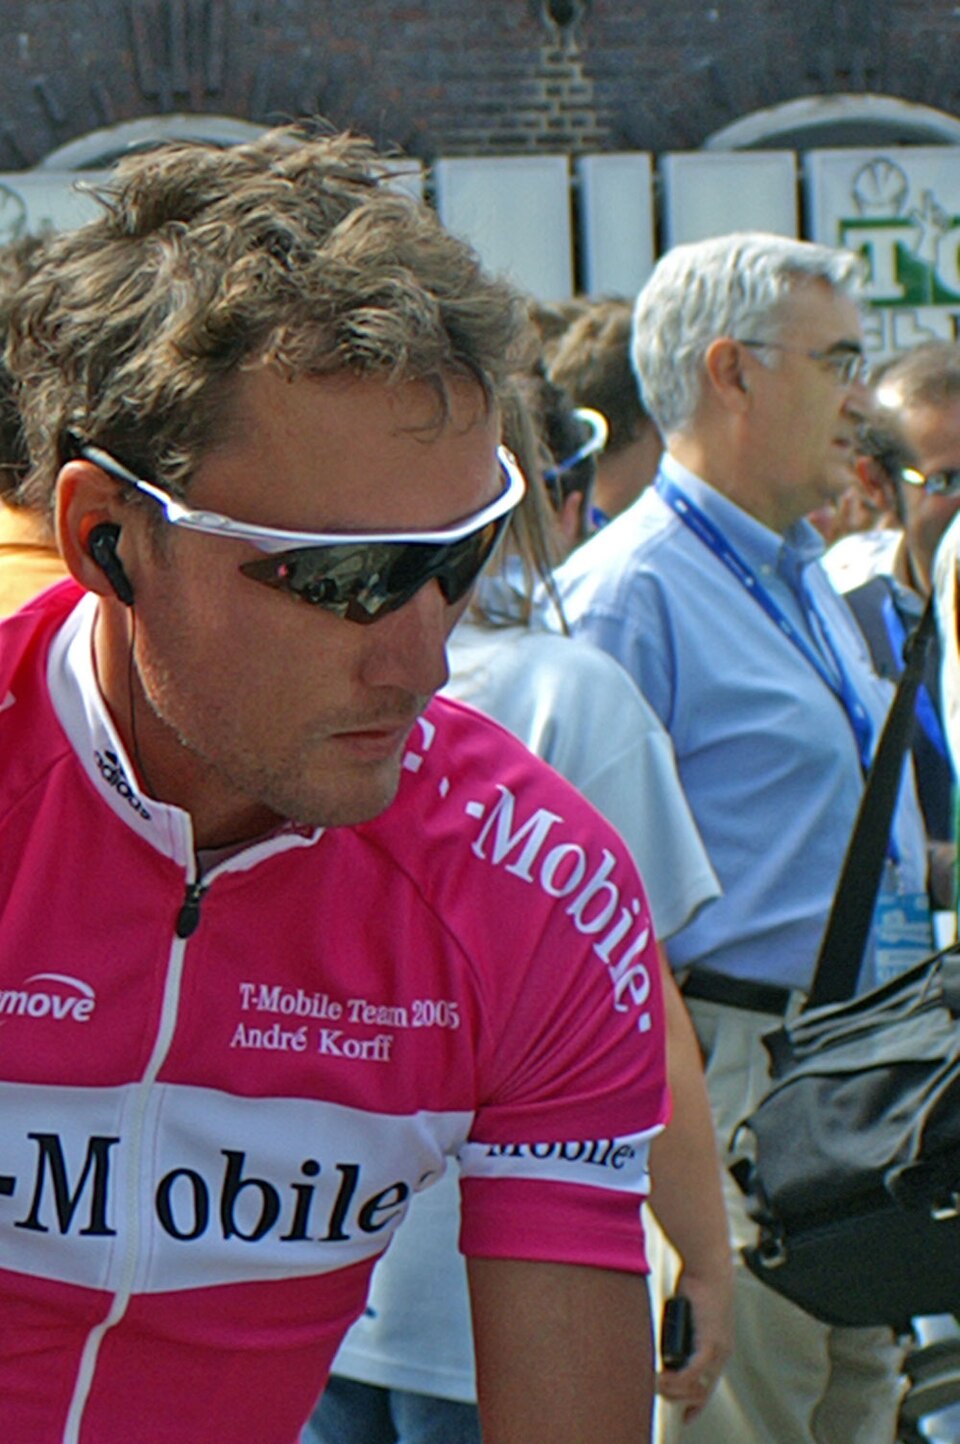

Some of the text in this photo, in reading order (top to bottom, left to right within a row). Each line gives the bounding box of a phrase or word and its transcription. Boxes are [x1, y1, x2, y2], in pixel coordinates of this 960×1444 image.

[240, 983, 460, 1029] T-Mobile Team 2005
[230, 1022, 393, 1062] André Korff
